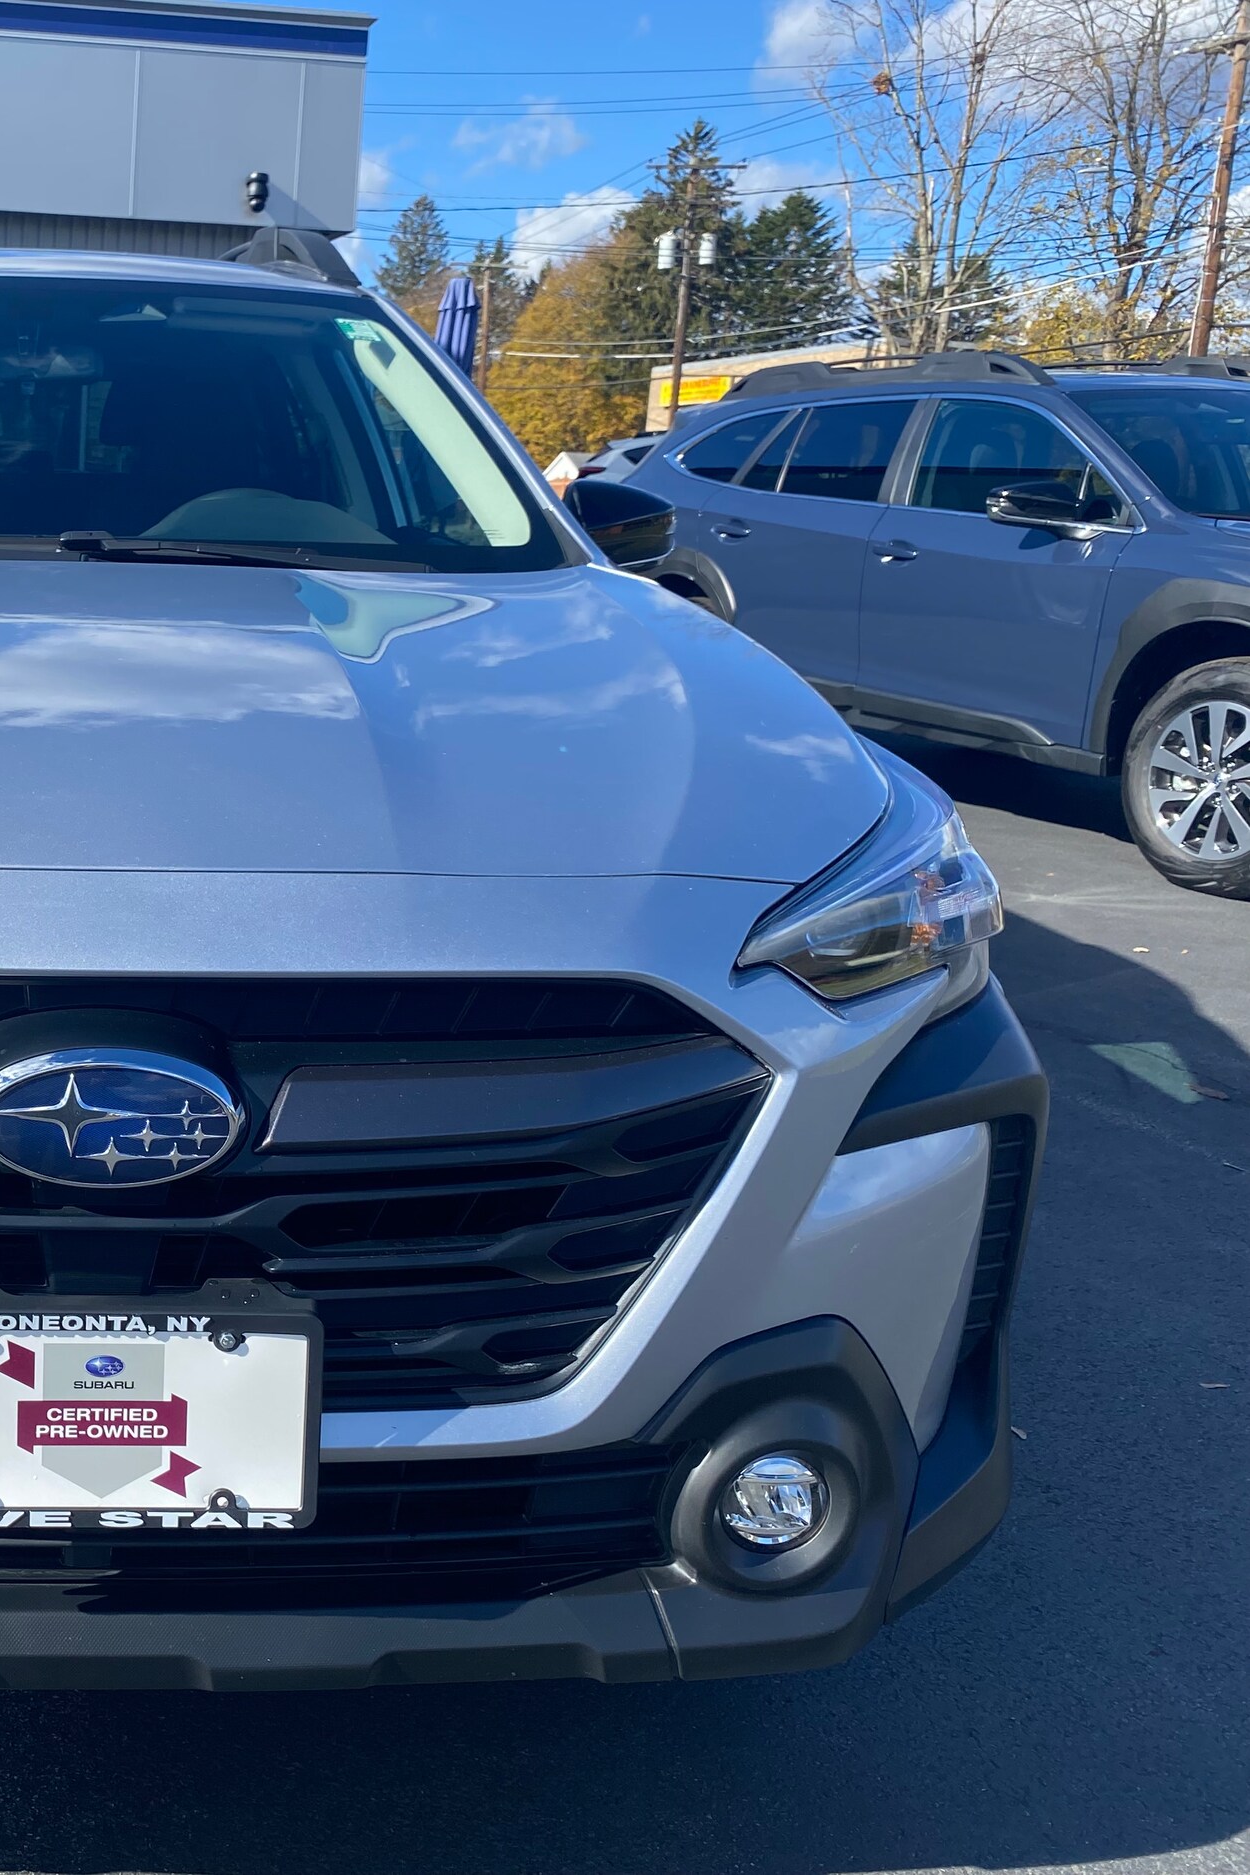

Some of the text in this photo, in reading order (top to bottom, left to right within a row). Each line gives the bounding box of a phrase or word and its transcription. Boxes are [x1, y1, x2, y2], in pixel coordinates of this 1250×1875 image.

[166, 1315, 211, 1332] NY
[73, 1380, 135, 1389] SUBARU
[46, 1407, 158, 1421] CERTIFIED
[35, 1425, 169, 1439] PRE-OWNED
[98, 1511, 296, 1529] STAR
